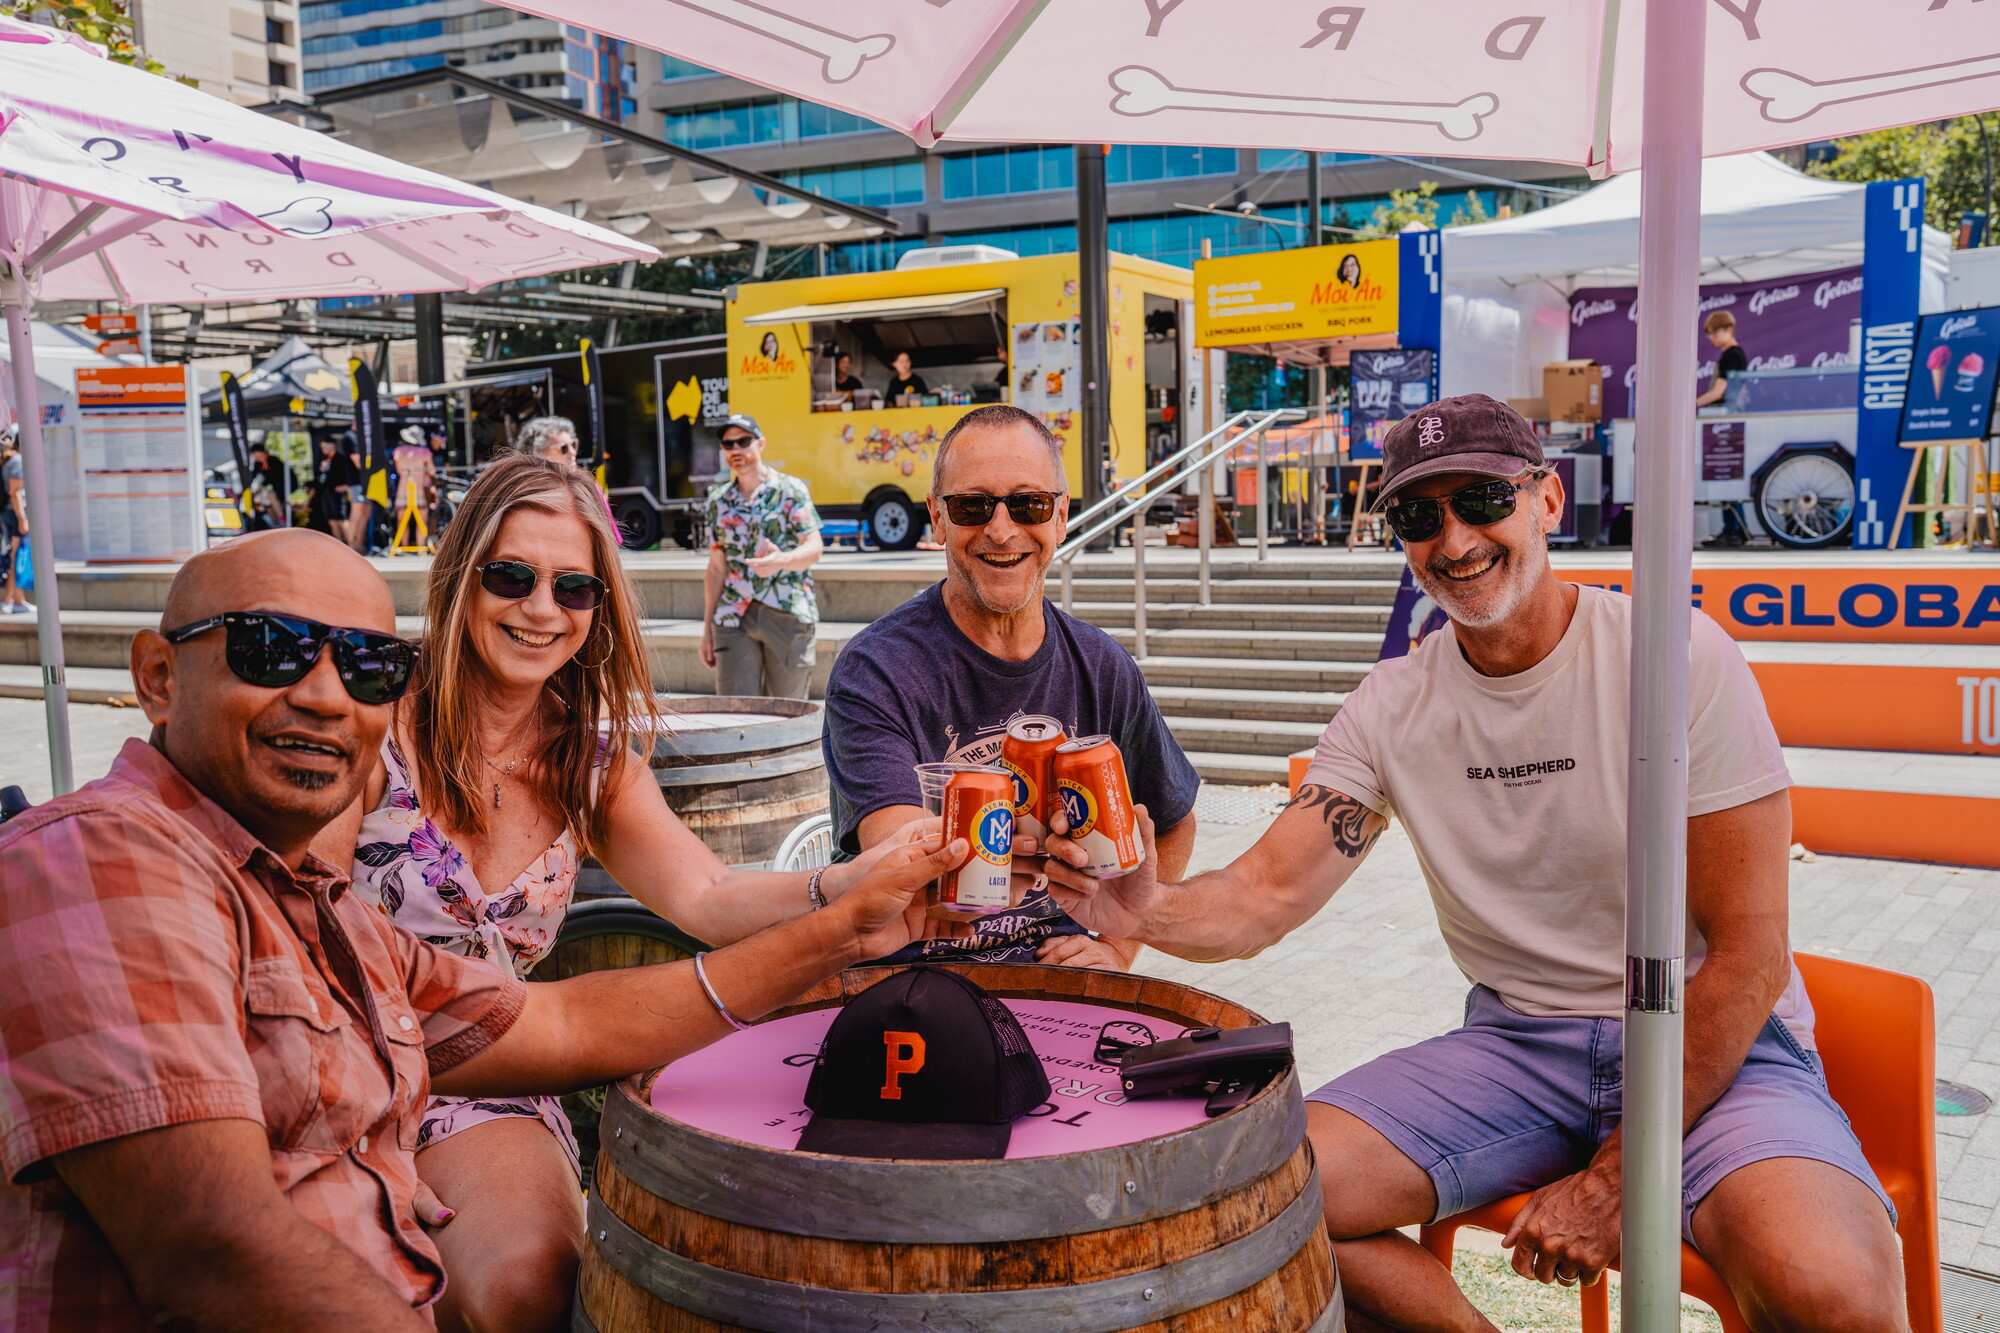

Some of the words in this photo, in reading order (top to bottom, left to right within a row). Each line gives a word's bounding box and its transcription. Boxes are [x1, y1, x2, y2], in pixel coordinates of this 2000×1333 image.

[701, 377, 729, 391] TOU
[703, 403, 729, 418] CUR
[960, 747, 987, 763] THE
[1467, 767, 1495, 779] SEA
[1498, 758, 1576, 779] SHEPHERD
[989, 877, 1007, 886] LAGER
[881, 1031, 926, 1099] P
